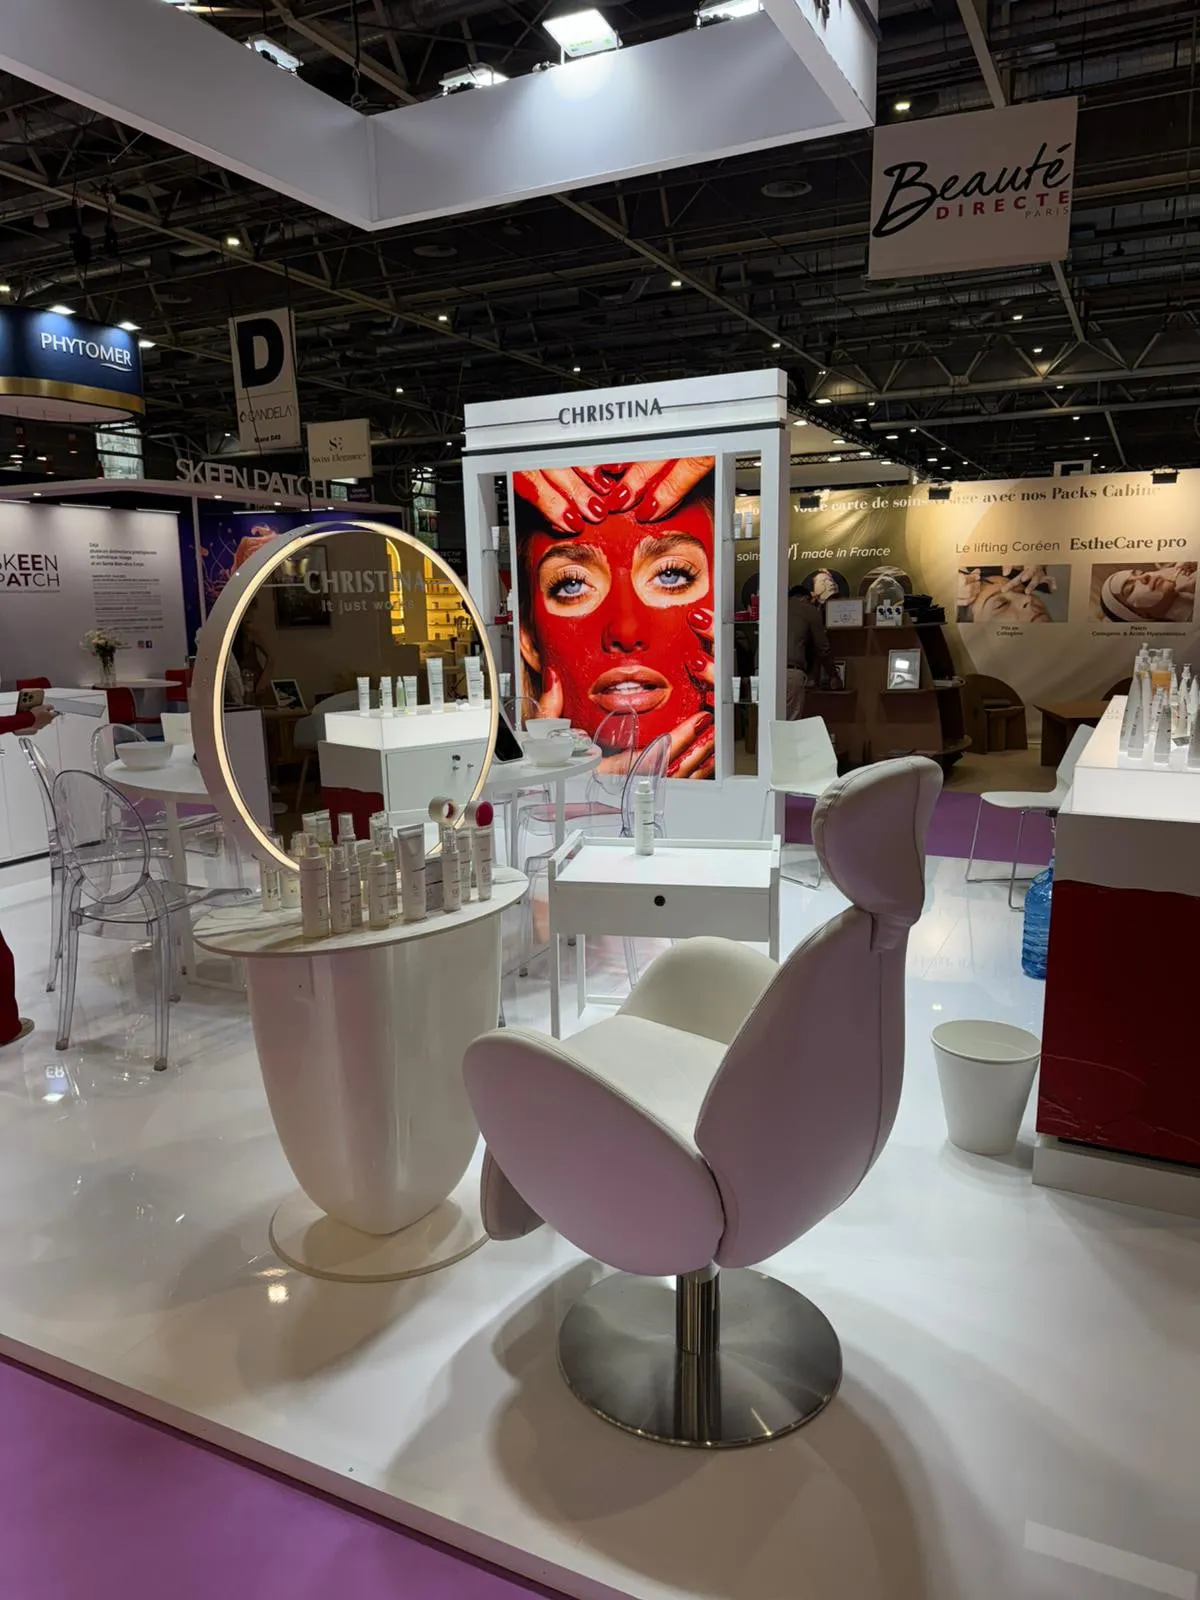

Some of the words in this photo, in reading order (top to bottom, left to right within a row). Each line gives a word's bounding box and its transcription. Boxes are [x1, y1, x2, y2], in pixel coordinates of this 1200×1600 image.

[872, 142, 1072, 238] Beauté
[935, 190, 1070, 220] DIRECTE
[1024, 206, 1069, 219] PARIS
[41, 332, 132, 367] PHYTOMER
[236, 318, 285, 390] D
[247, 404, 292, 422] CANDELA
[558, 397, 662, 425] CHRISTINA
[176, 458, 249, 490] SKEEN
[253, 469, 328, 499] PATCH
[831, 499, 868, 511] carte
[871, 496, 889, 509] de
[892, 496, 927, 509] soin
[983, 492, 1017, 504] avec
[1021, 490, 1047, 501] nos
[1052, 485, 1098, 500] Packs
[736, 551, 760, 562] soin
[801, 548, 834, 560] made
[836, 547, 847, 558] in
[849, 546, 891, 558] France
[955, 543, 970, 554] Le
[974, 540, 1008, 555] lifting
[1012, 540, 1060, 552] Coréen
[1069, 536, 1154, 551] EstheCare
[1157, 537, 1187, 552] pro
[0, 553, 58, 571] KEEN
[303, 569, 425, 594] CHRISTINA
[339, 599, 367, 615] just
